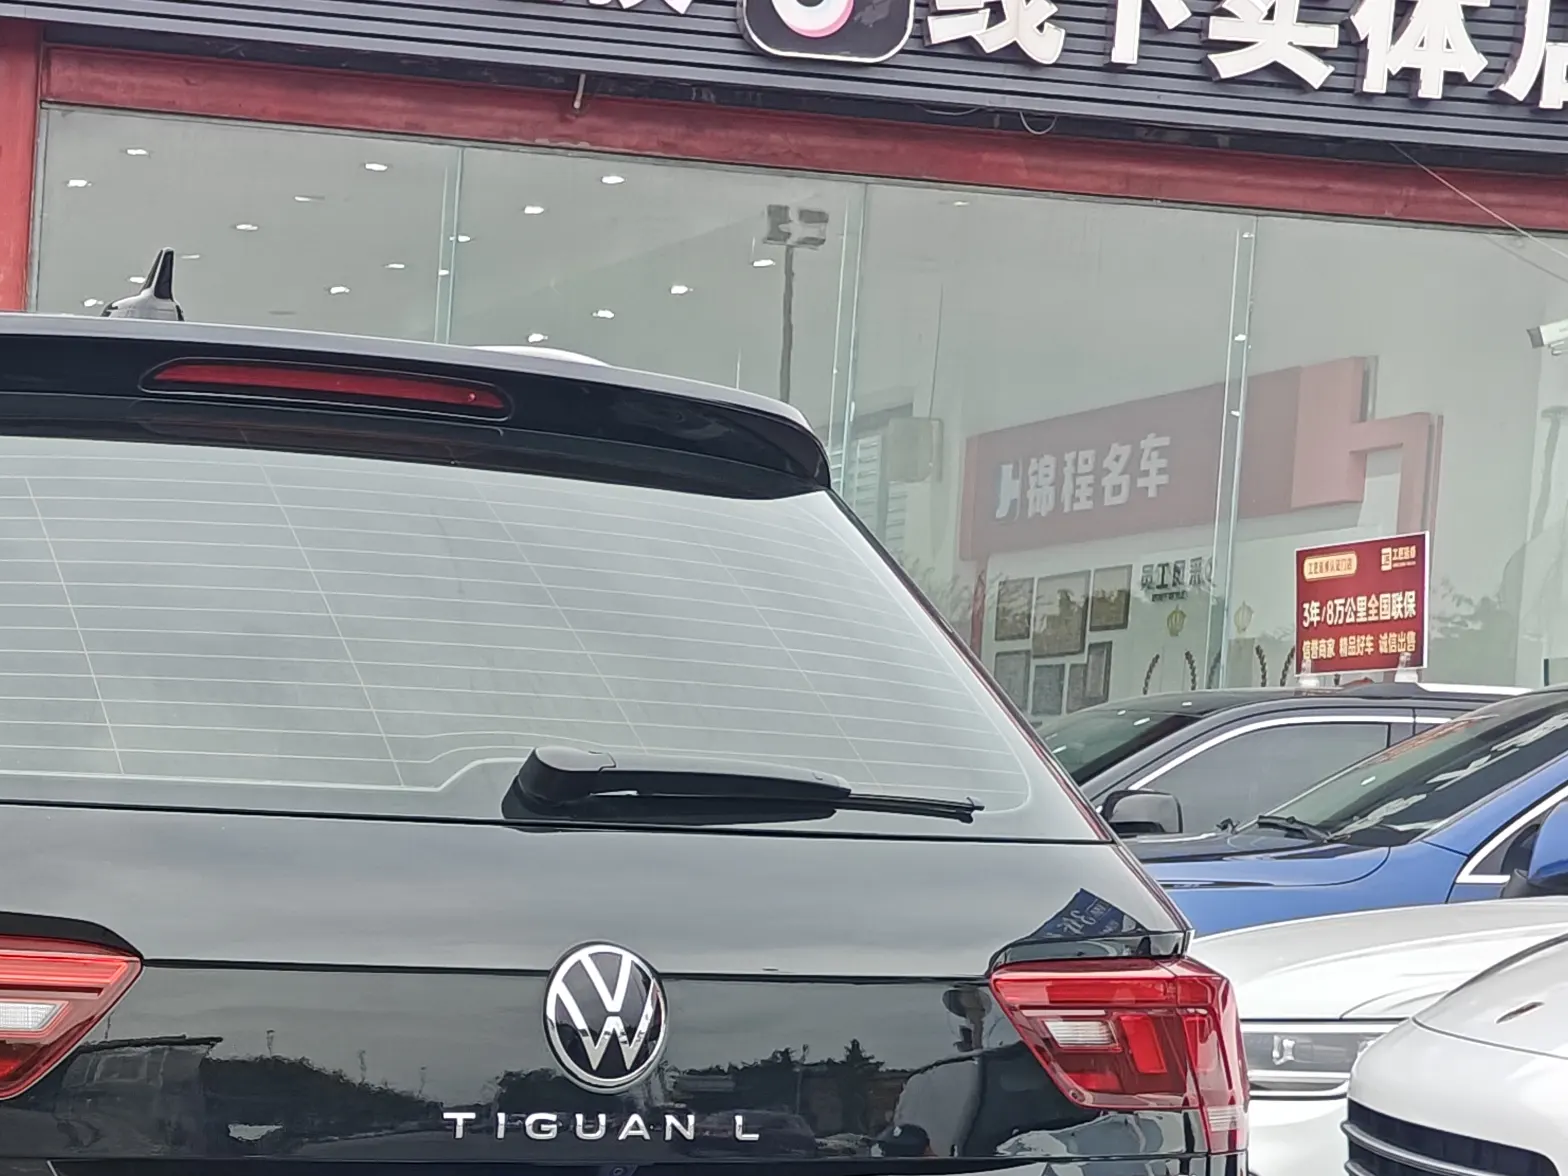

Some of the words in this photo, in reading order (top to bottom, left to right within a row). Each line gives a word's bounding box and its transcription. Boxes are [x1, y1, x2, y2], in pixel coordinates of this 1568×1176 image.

[1026, 433, 1171, 519] 锦程名车
[1302, 591, 1416, 627] 3年/8万公里全国联保
[1339, 634, 1374, 657] 精品好车
[1379, 631, 1416, 654] 诚信出售
[442, 1112, 696, 1141] TIGUAN
[735, 1115, 760, 1141] L
